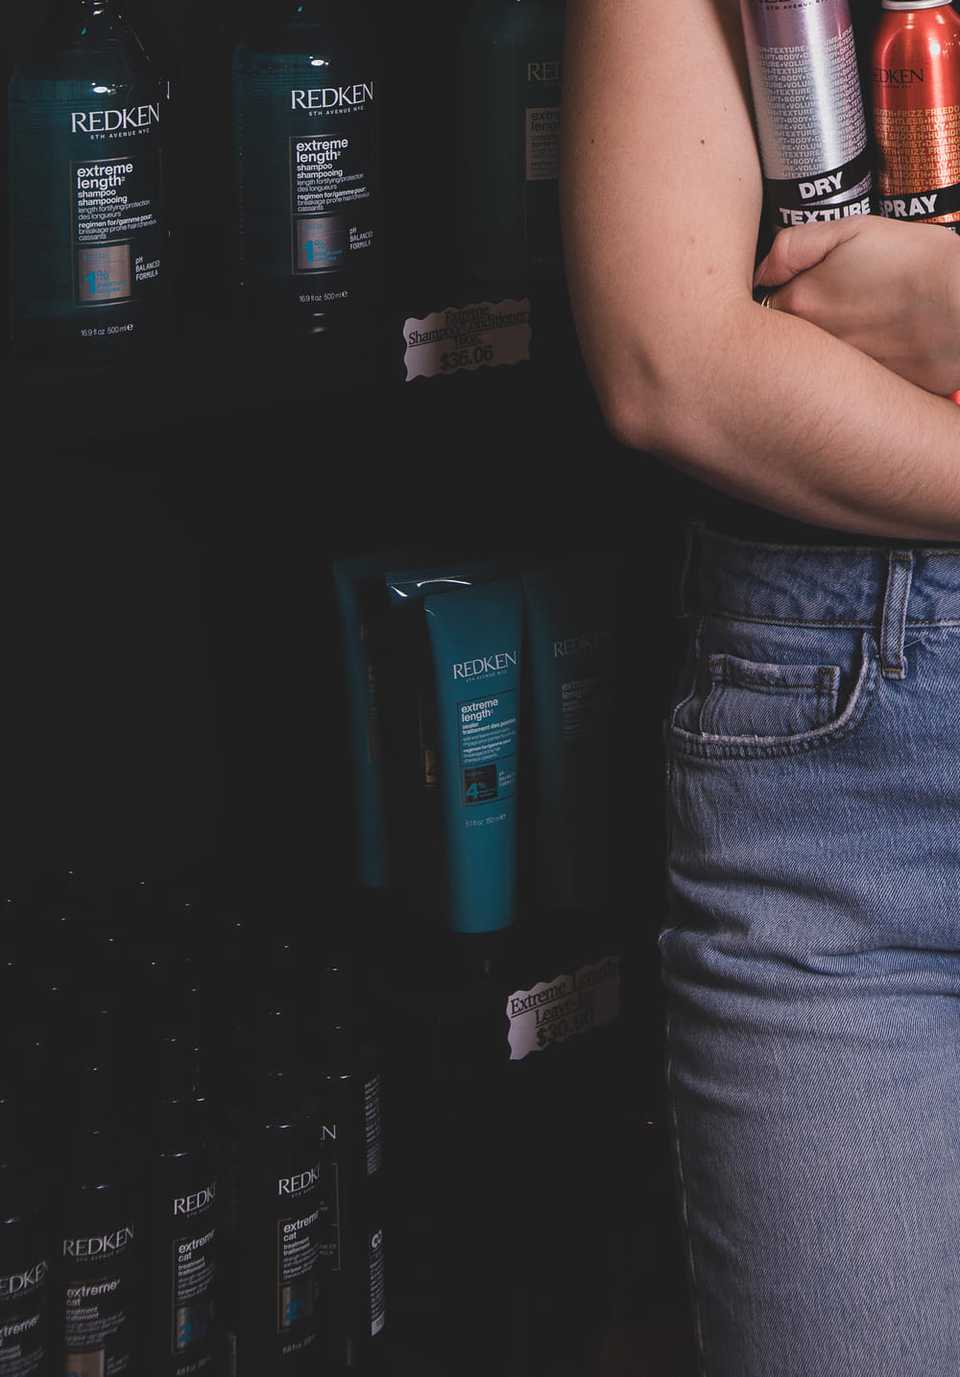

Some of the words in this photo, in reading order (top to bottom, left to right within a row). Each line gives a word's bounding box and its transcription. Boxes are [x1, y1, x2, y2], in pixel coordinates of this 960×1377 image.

[291, 81, 374, 110] REDKEN
[70, 102, 160, 134] REDKEN
[325, 107, 351, 116] AVENUE
[108, 129, 137, 139] AVENUE
[296, 137, 350, 153] extreme
[76, 162, 134, 179] extreme
[296, 162, 335, 174] shampoo
[297, 169, 344, 185] shampooing
[77, 187, 117, 200] shampoo
[798, 171, 845, 201] DRY
[78, 194, 129, 209] shampooing
[780, 196, 873, 226] TEXTURE
[453, 651, 518, 681] REDKEN
[460, 697, 500, 714] extreme
[63, 1223, 135, 1257] REDKEN
